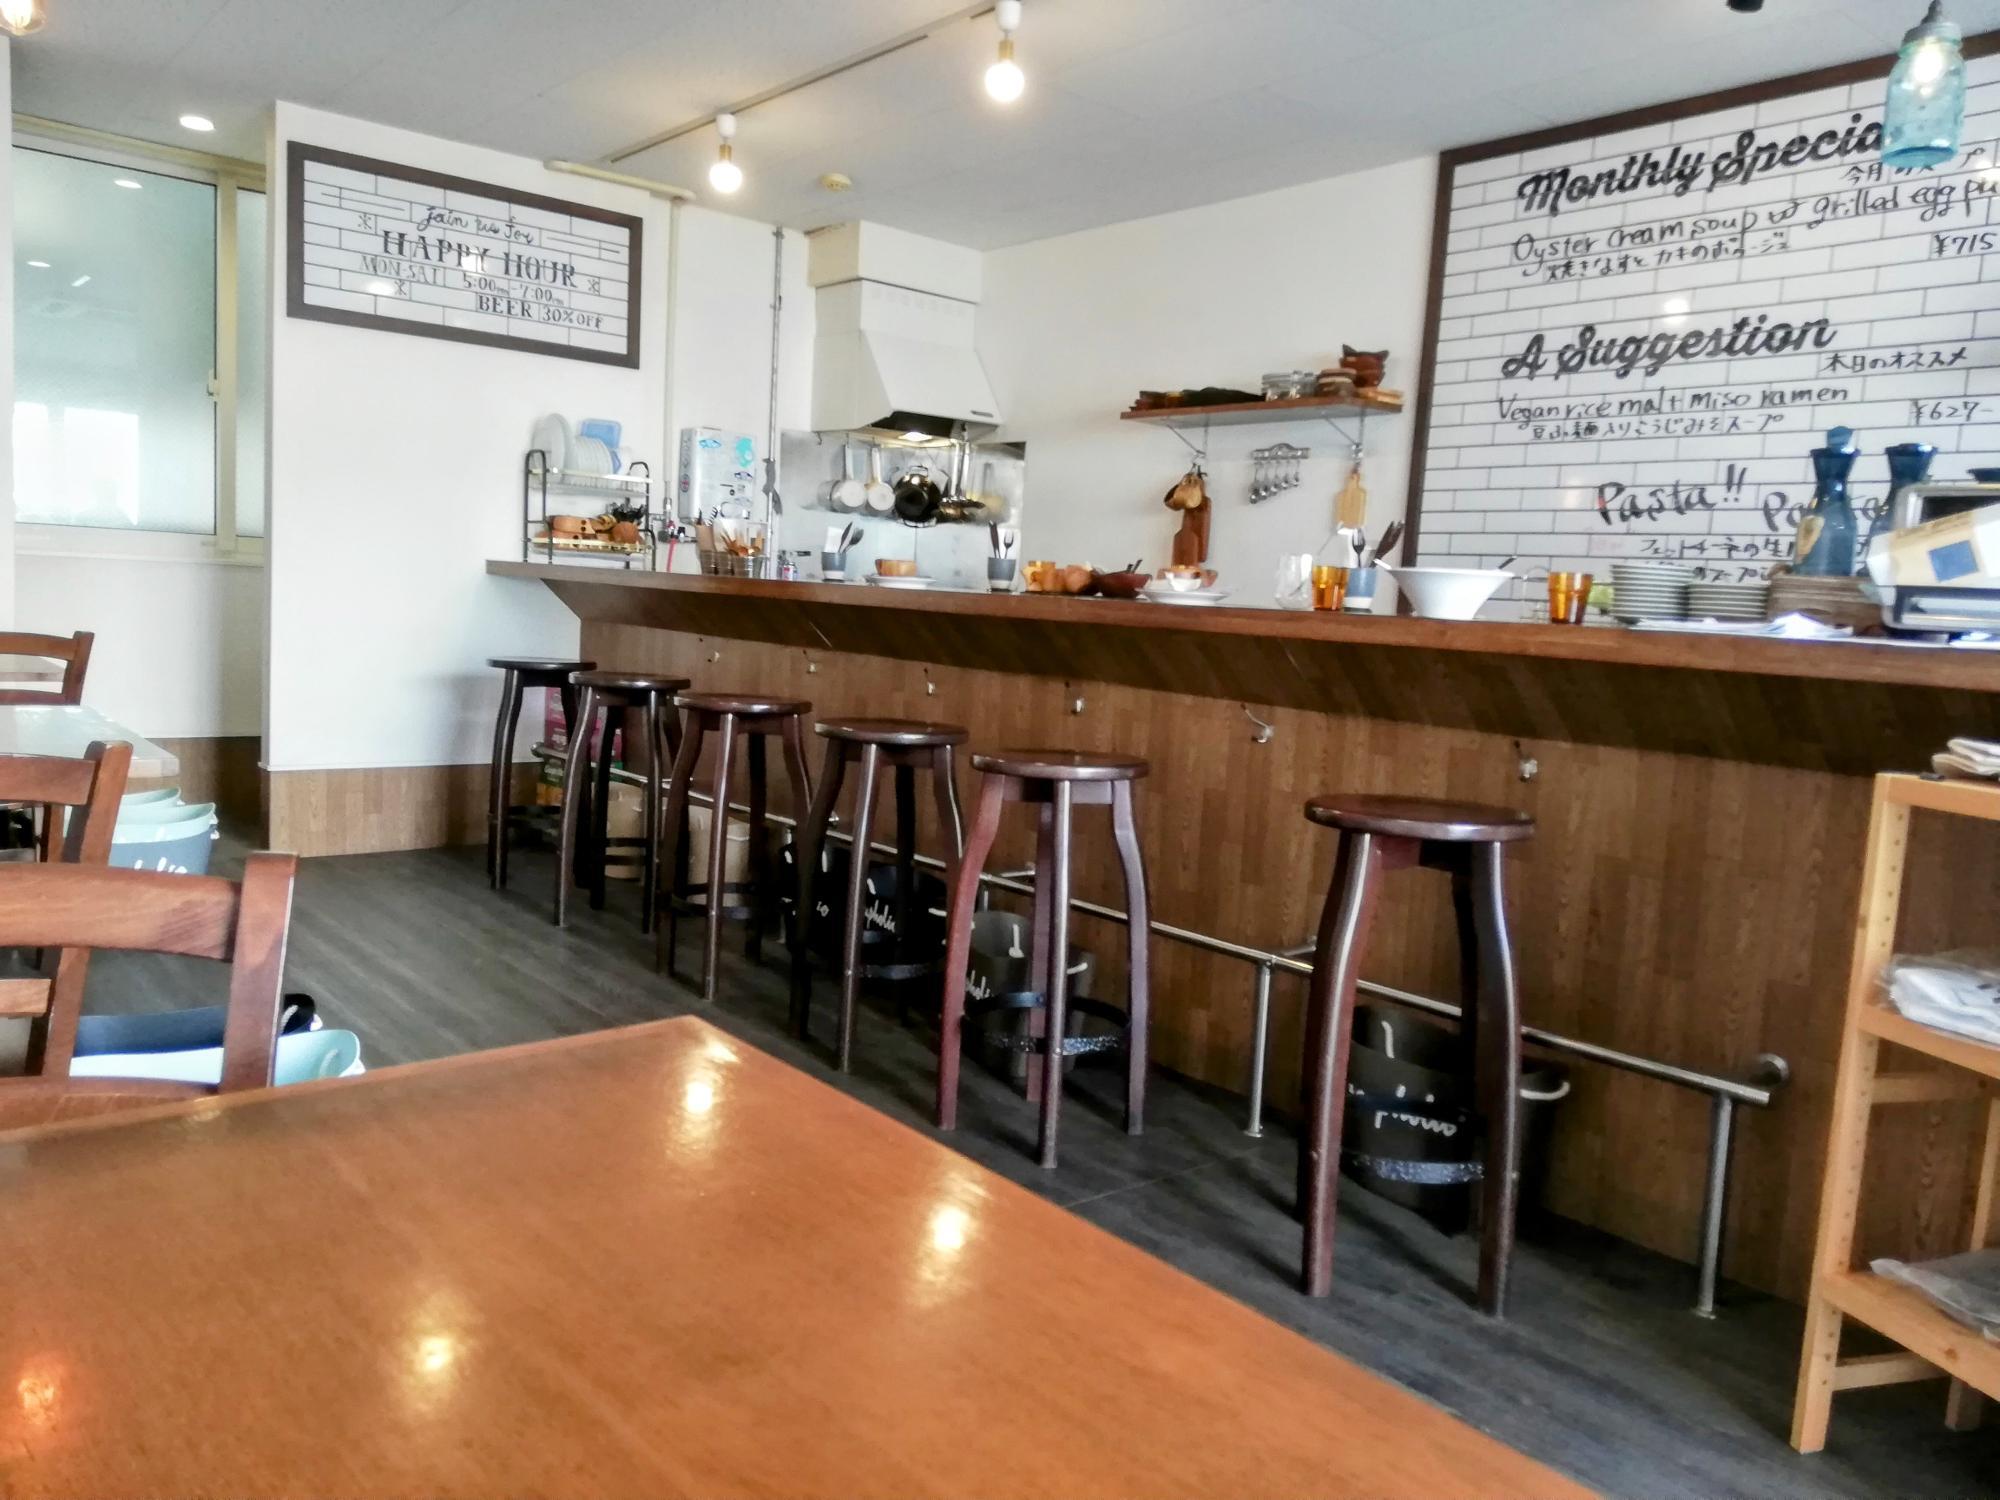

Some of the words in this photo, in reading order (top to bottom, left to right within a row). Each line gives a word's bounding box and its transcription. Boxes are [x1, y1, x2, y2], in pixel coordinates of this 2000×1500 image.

[1517, 145, 1705, 217] Monthly
[1706, 112, 1884, 193] Specia
[382, 229, 491, 273] HAPPY
[503, 250, 578, 289] HOUR
[1513, 233, 1597, 277] Oyster
[1690, 211, 1758, 256] soup
[1910, 184, 1957, 222] egg
[478, 294, 533, 319] BEER
[1500, 333, 1548, 380] A
[1553, 313, 1837, 381] Suggestion
[1819, 346, 1968, 374] 本日のオススメ
[1499, 393, 1560, 430] Vegan
[1565, 401, 1612, 419] rice
[1760, 386, 1849, 409] ramen
